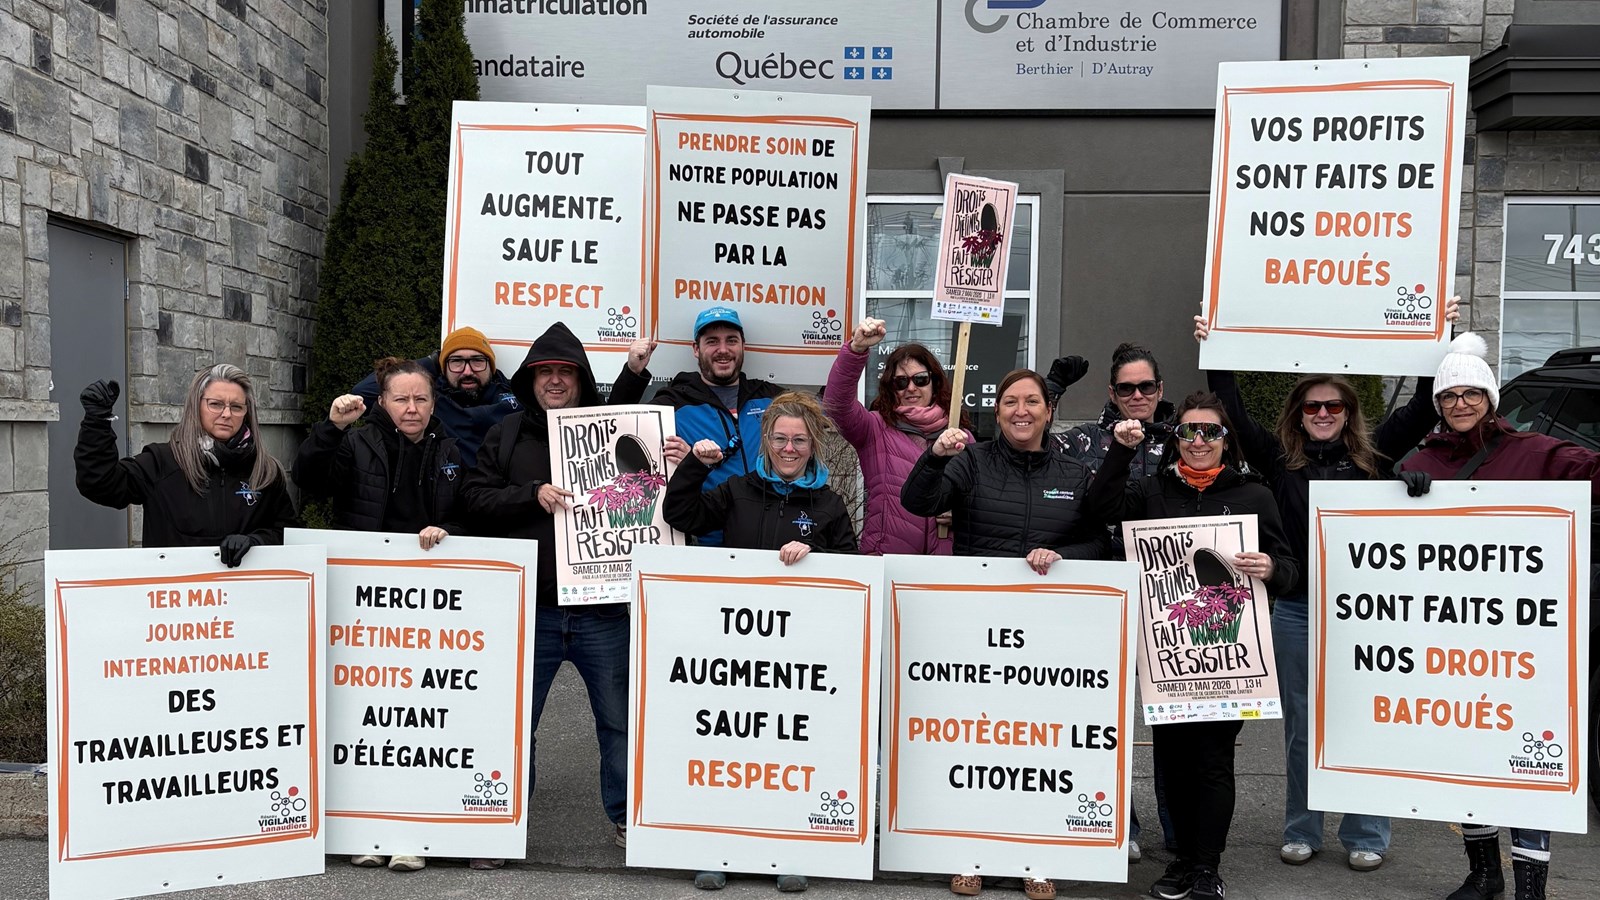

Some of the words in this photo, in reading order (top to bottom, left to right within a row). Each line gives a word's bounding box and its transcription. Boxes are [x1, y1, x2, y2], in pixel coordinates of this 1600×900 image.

[461, 0, 647, 15] mmatriculation
[688, 14, 739, 25] Société
[743, 15, 759, 25] de
[763, 15, 838, 25] l'assurance
[688, 28, 765, 39] automobile
[1016, 12, 1109, 29] Chambre
[1120, 13, 1142, 29] de
[1152, 12, 1257, 30] Commerce
[1016, 37, 1034, 52] et
[472, 54, 585, 78] andataire
[716, 51, 835, 85] Québec
[1016, 63, 1073, 75] Berthier
[1251, 117, 1302, 142] VOS
[1313, 115, 1425, 142] PROFITS
[679, 132, 760, 153] PRENDRE
[766, 137, 807, 155] SOIN
[812, 139, 835, 157] DE
[525, 151, 584, 175] TOUT
[669, 164, 726, 184] NOTRE
[732, 168, 838, 190] POPULATION
[1236, 164, 1308, 190] SONT
[1315, 164, 1387, 189] FAITS
[1398, 163, 1435, 189] DE
[481, 193, 621, 223] AUGMENTE,
[678, 201, 705, 223] NE
[713, 203, 779, 228] PASSE
[787, 207, 826, 229] PAS
[1250, 211, 1305, 237] NOS
[1315, 211, 1412, 238] DROITS
[502, 238, 564, 262] SAUF
[571, 240, 598, 264] LE
[715, 243, 754, 264] PAR
[762, 245, 787, 266] LA
[952, 247, 970, 265] FAUT
[1265, 252, 1391, 286] BAFOUÉS
[495, 282, 603, 309] RESPECT
[675, 278, 826, 306] PRIVATISATION
[572, 504, 604, 531] FAUT
[573, 565, 601, 575] SAMEDI
[603, 565, 607, 573] 2
[609, 564, 623, 573] MAI
[1349, 542, 1406, 571] VOS
[1418, 544, 1544, 573] PROFITS
[147, 589, 181, 609] 1ER
[188, 589, 228, 607] MAI:
[356, 585, 426, 610] MERCI
[433, 589, 462, 611] DE
[1336, 594, 1414, 622] SONT
[1424, 595, 1504, 626] FAITS
[1516, 598, 1558, 627] DE
[146, 616, 235, 642] JOURNÉE
[721, 607, 791, 637] TOUT
[1151, 621, 1185, 649] FAUT
[330, 619, 431, 649] PIÉTINER
[439, 629, 485, 652] NOS
[988, 628, 1025, 649] LES
[104, 652, 269, 678] INTERNATIONALE
[1355, 644, 1414, 674] NOS
[1426, 647, 1535, 680] DROITS
[334, 664, 413, 688] DROITS
[421, 668, 478, 690] AVEC
[669, 656, 838, 695] AUGMENTE,
[908, 662, 1109, 689] CONTRE-POUVOIRS
[1157, 682, 1186, 692] SAMEDI
[1188, 682, 1193, 690] 2
[1195, 681, 1210, 690] MAI
[1212, 680, 1231, 690] 2026
[1245, 679, 1254, 688] 13
[1256, 679, 1262, 687] H
[168, 688, 216, 713] DES
[1373, 693, 1514, 731] BAFOUÉS
[362, 705, 449, 728] AUTANT
[696, 709, 768, 738] SAUF
[778, 713, 809, 741] LE
[74, 727, 268, 764] TRAVAILLEUSES
[278, 724, 305, 746] ET
[908, 712, 1063, 747] PROTÈGENT
[1071, 725, 1118, 750] LES
[333, 738, 474, 769] D'ÉLÉGANCE
[1509, 760, 1563, 770] VIGILANCE
[102, 768, 279, 804] TRAVAILLEURS
[688, 759, 815, 792] RESPECT
[949, 764, 1073, 794] CITOYENS
[258, 816, 306, 826] VIGILANCE
[808, 817, 854, 826] VIGILANCE
[1066, 819, 1112, 827] VIGILANCE
